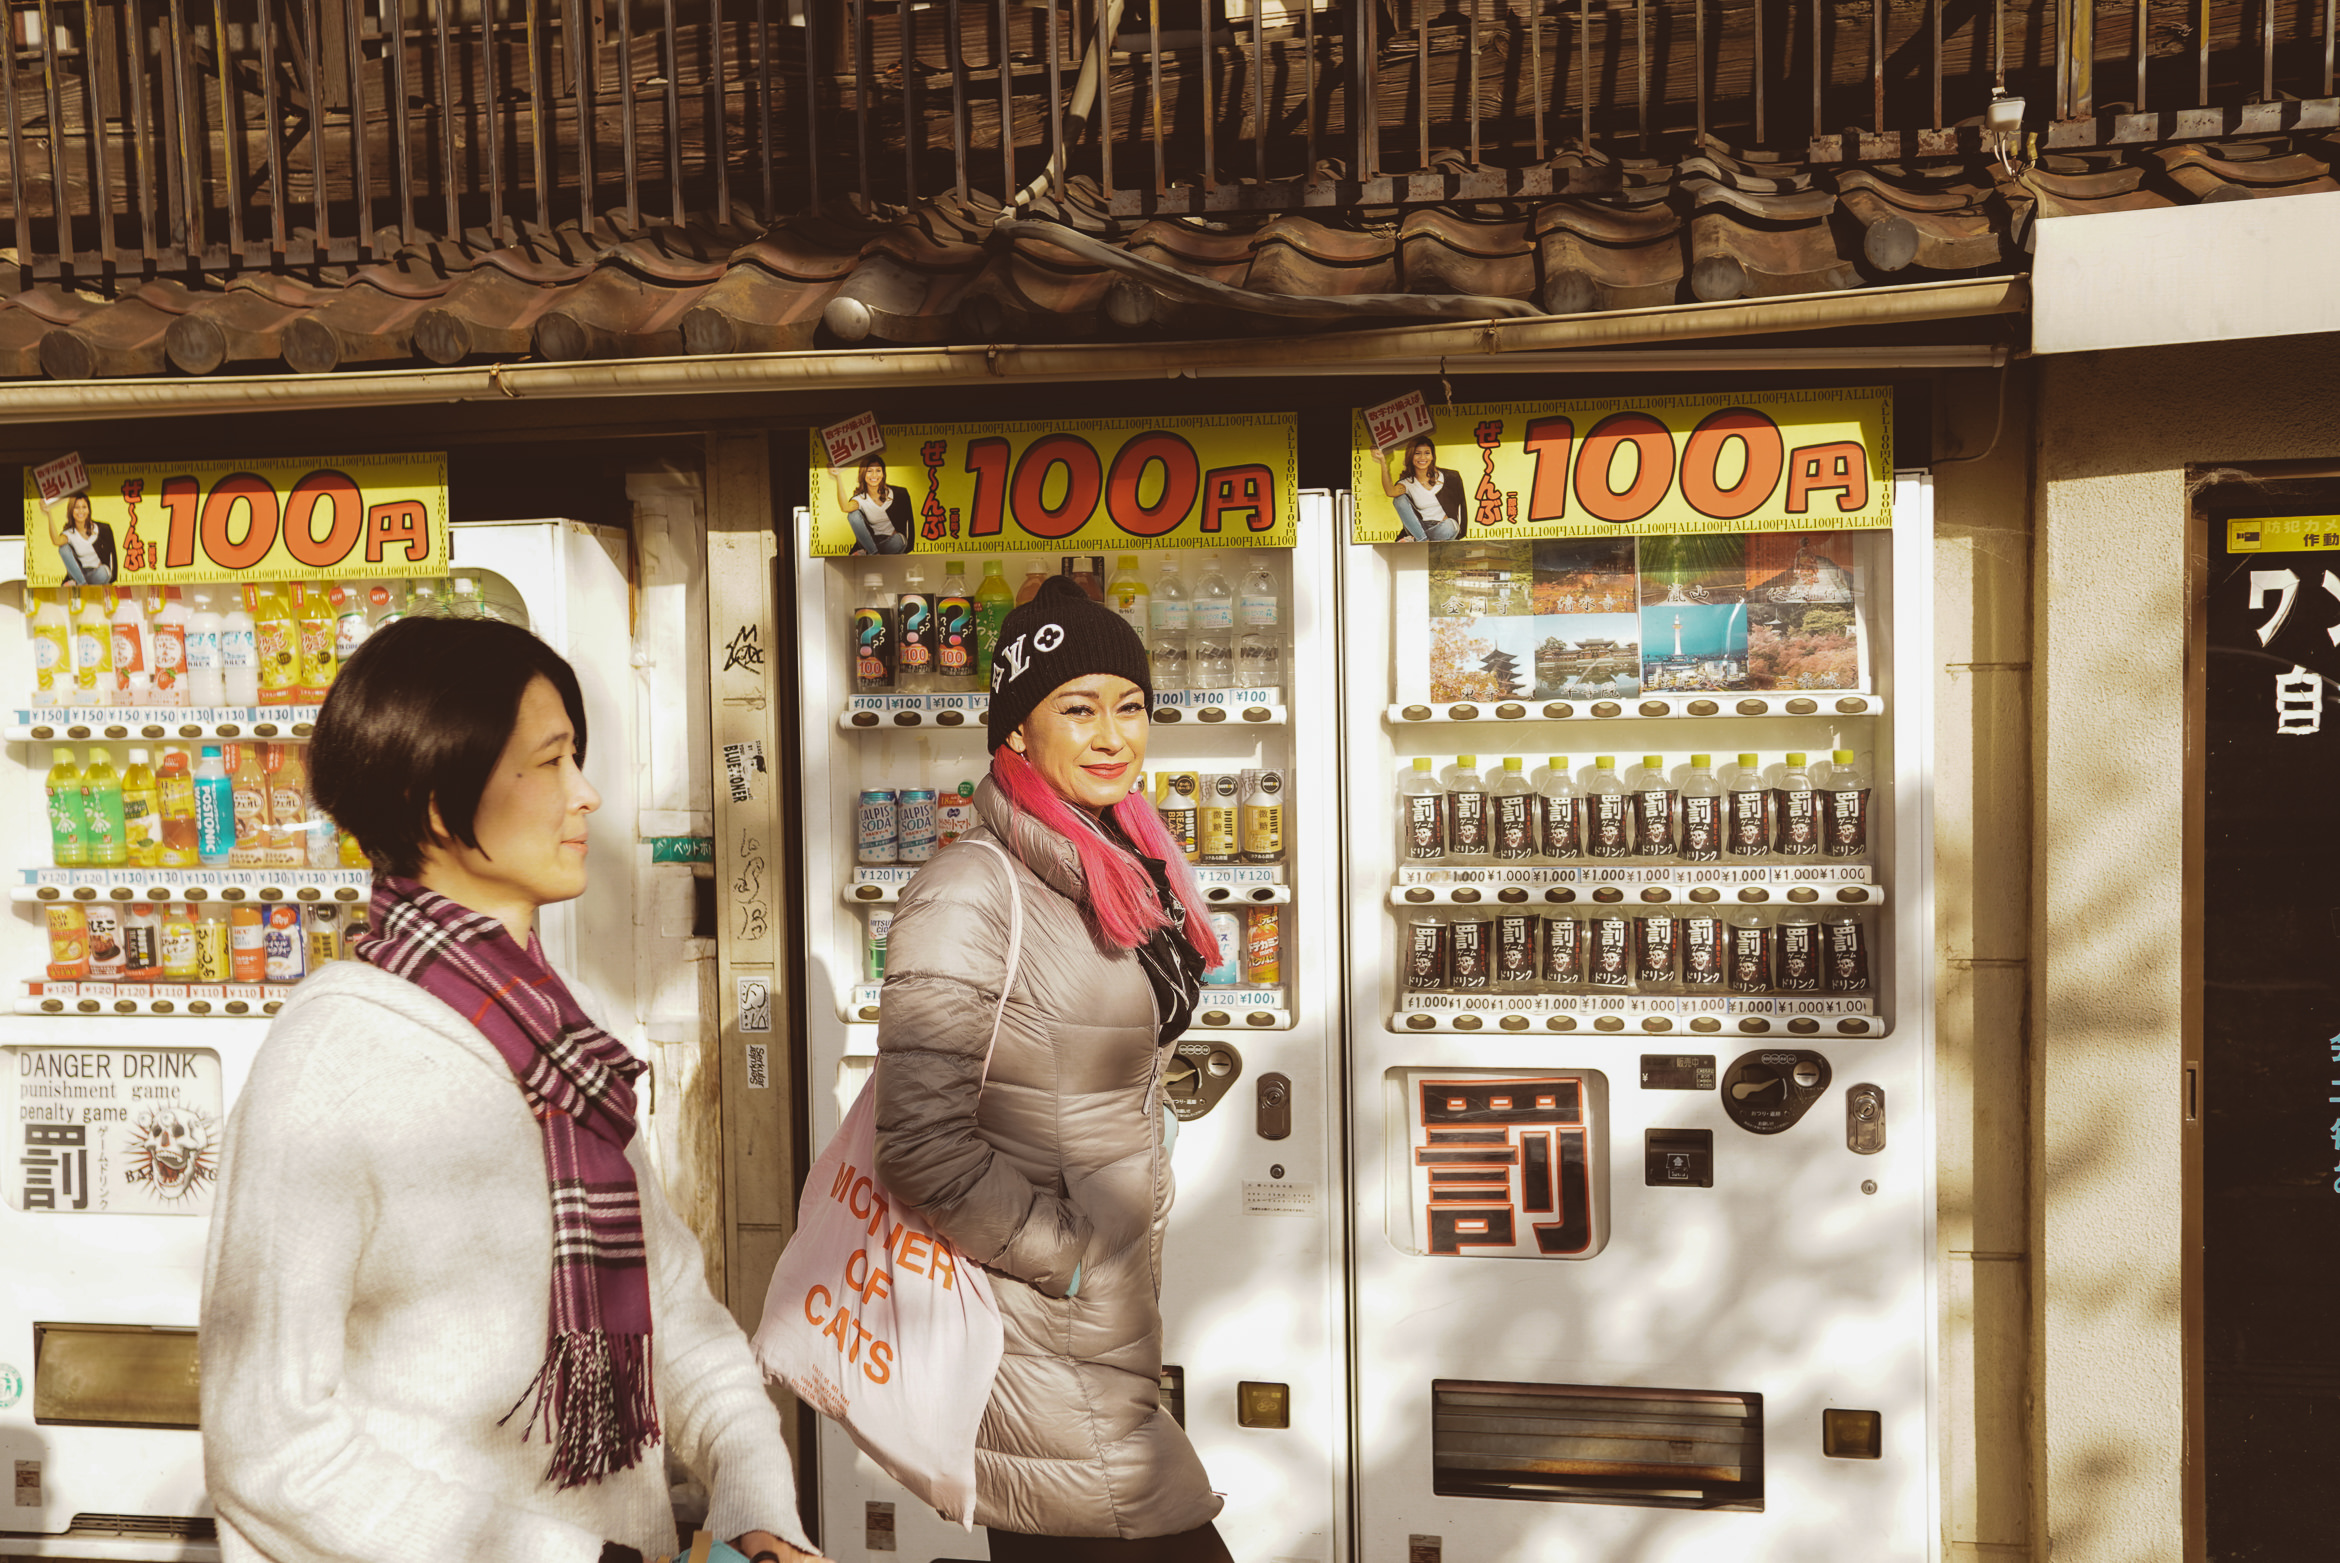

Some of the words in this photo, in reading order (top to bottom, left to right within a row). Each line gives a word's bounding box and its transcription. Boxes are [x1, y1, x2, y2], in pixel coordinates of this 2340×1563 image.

[1523, 406, 1868, 523] 100円
[965, 430, 1275, 540] 100円
[161, 468, 429, 570] 100円
[372, 593, 386, 602] NEW
[854, 698, 882, 708] ¥100
[891, 698, 921, 708] ¥100
[933, 698, 963, 708] ¥100
[1193, 693, 1224, 704] ¥100
[1236, 691, 1266, 702] ¥100
[32, 710, 62, 721] ¥150
[73, 710, 104, 721] ¥150
[109, 710, 139, 721] ¥150
[145, 710, 175, 722] ¥150
[181, 709, 210, 721] ¥130
[217, 710, 245, 720] ¥130
[259, 709, 289, 720] ¥130
[297, 709, 318, 720] ¥13
[860, 805, 890, 821] CALPIS
[900, 804, 930, 821] CALPIS
[1412, 797, 1434, 822] 罰
[1457, 793, 1481, 818] 罰
[1501, 797, 1525, 822] 罰
[1548, 797, 1571, 822] 罰
[1599, 794, 1621, 820] 罰
[1644, 791, 1667, 817] 罰
[1687, 798, 1711, 824] 罰
[1737, 792, 1761, 818] 罰
[1788, 791, 1812, 817] 罰
[1834, 791, 1859, 818] 罰
[201, 785, 216, 854] POSTONIC
[862, 818, 892, 832] SODA
[902, 817, 932, 832] SODA
[1176, 811, 1184, 835] REAL
[861, 870, 890, 880] ¥120
[1200, 871, 1231, 881] ¥120
[1239, 871, 1271, 881] ¥120
[1415, 928, 1436, 952] 罰
[1455, 925, 1478, 949] 罰
[1502, 918, 1525, 943] 罰
[1551, 921, 1574, 946] 罰
[1601, 921, 1624, 947] 罰
[1646, 919, 1671, 944] 罰
[1688, 919, 1713, 945] 罰
[1785, 928, 1808, 952] 罰
[1832, 926, 1857, 952] 罰
[1737, 930, 1760, 956] 罰
[1203, 994, 1234, 1005] ¥120
[1827, 1000, 1866, 1012] ¥1.00
[20, 1053, 111, 1078] DANGER
[124, 1053, 198, 1079] DRINK
[20, 1081, 117, 1099] punishment
[132, 1085, 180, 1101] game
[20, 1103, 74, 1124] penalty
[83, 1107, 128, 1124] game
[20, 1124, 88, 1210] 罰
[1415, 1077, 1592, 1255] 罰
[845, 1249, 893, 1305] OF
[804, 1284, 893, 1385] CATS
